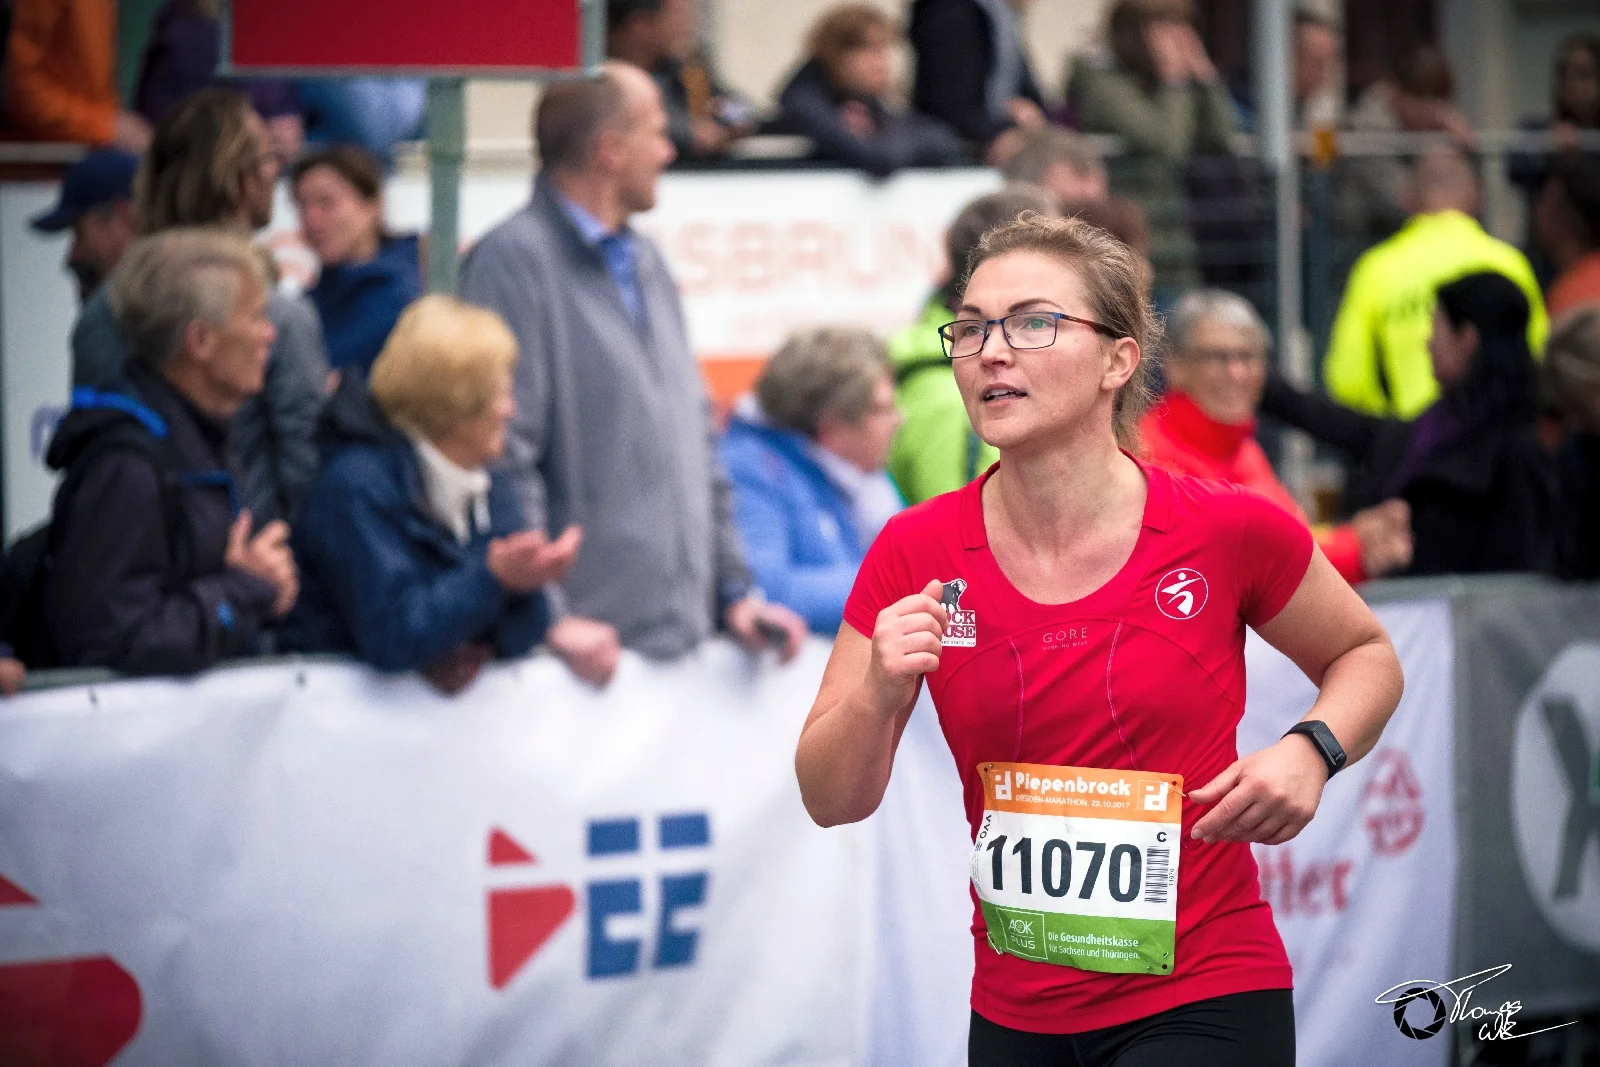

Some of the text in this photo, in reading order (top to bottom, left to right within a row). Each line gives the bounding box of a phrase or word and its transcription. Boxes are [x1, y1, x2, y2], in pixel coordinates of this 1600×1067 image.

[1042, 626, 1088, 643] GORE
[1015, 771, 1132, 796] Piepenbrock
[1015, 793, 1131, 809] DRESDEN-MARATHON, 22.10.2017
[1156, 831, 1168, 843] C
[986, 835, 1143, 902] 11070
[1008, 919, 1035, 935] AOK
[1011, 936, 1036, 950] PLUS
[1048, 932, 1139, 947] Die Gesundheitskasse
[1058, 945, 1085, 956] Sachsen
[1086, 948, 1100, 958] und
[1101, 949, 1141, 961] Thüringen.
